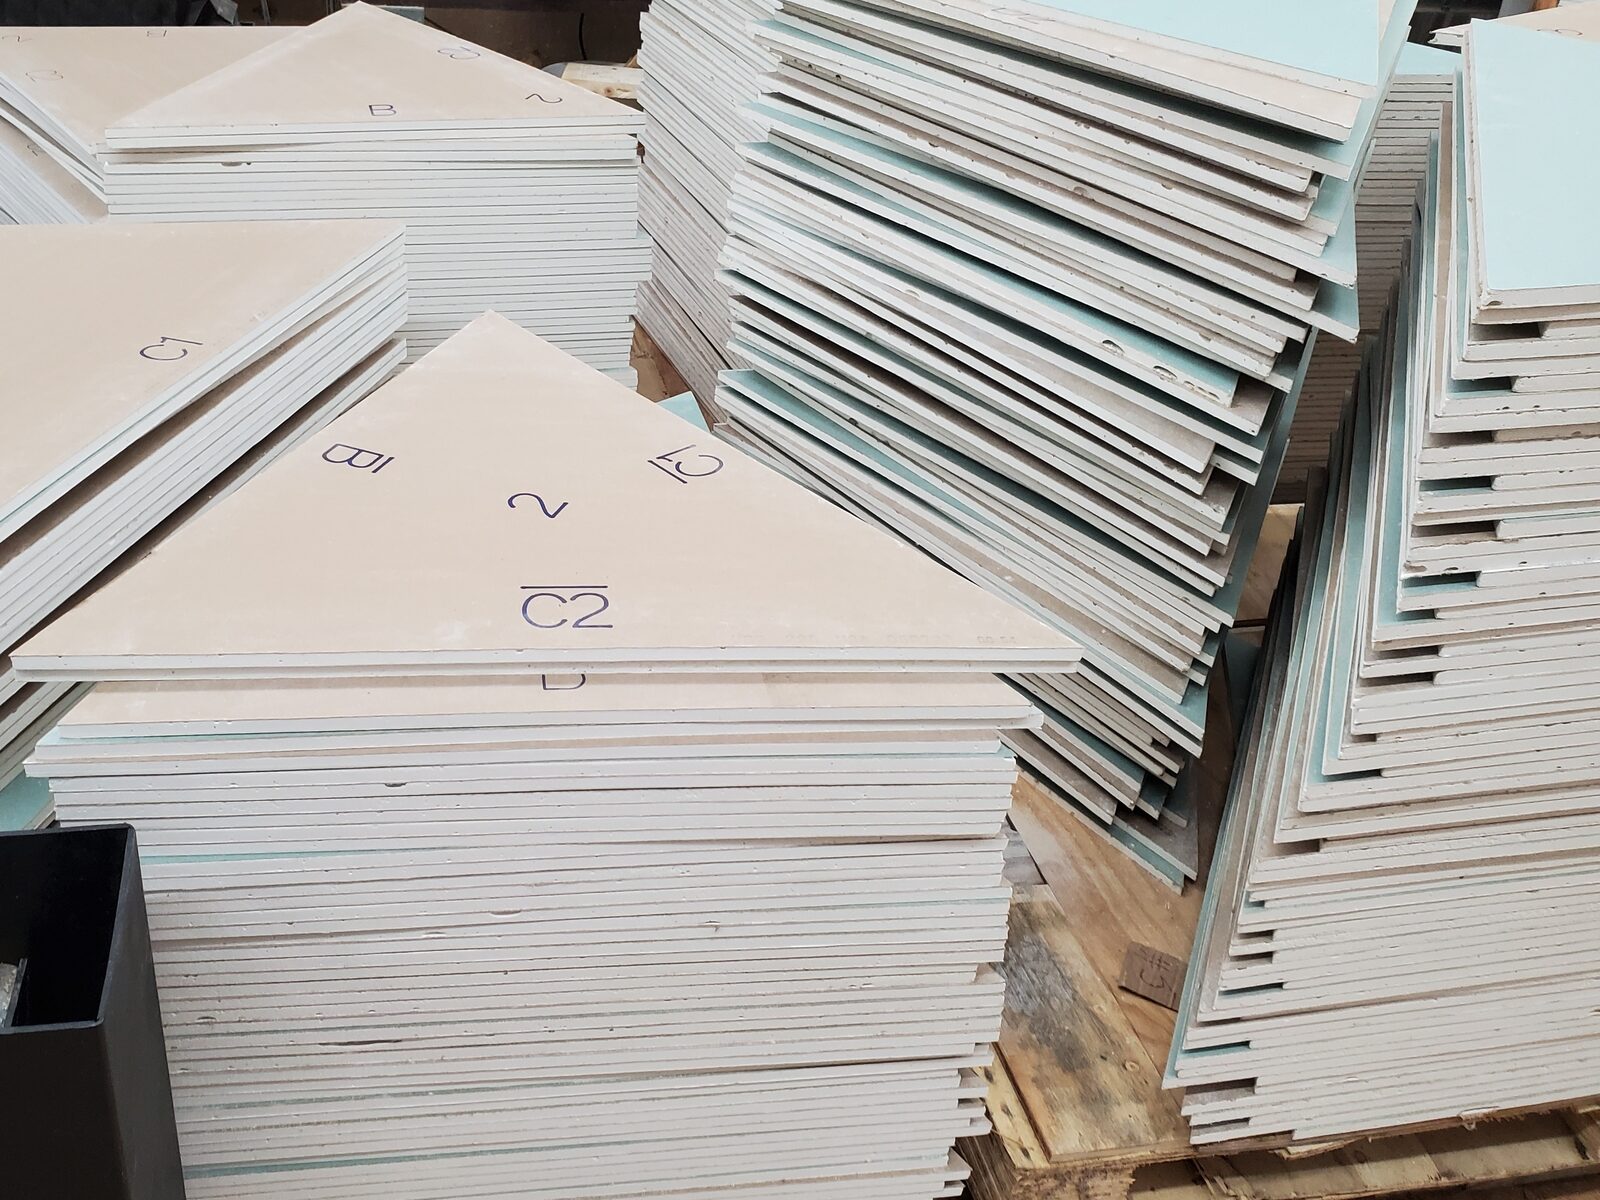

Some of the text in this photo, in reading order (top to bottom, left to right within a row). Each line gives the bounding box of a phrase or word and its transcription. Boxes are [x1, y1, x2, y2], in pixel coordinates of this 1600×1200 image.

[368, 104, 397, 117] B
[139, 336, 204, 361] C1
[507, 492, 569, 519] 2
[520, 589, 614, 629] C2
